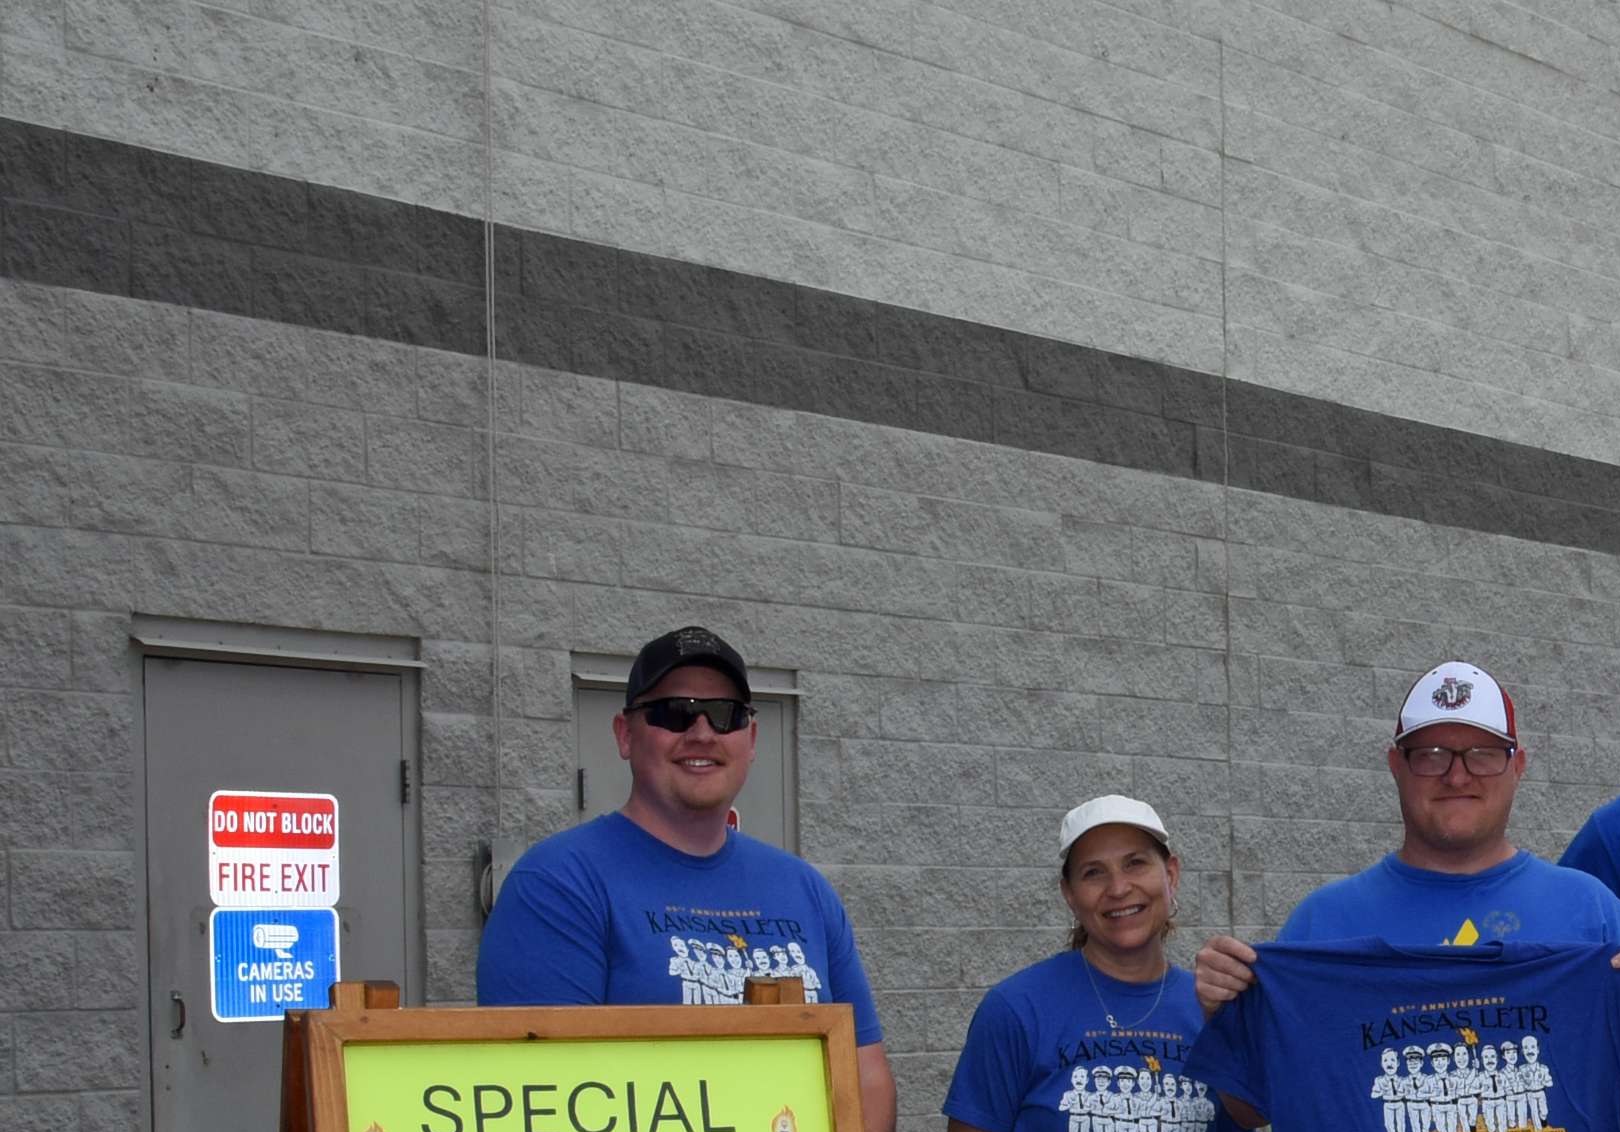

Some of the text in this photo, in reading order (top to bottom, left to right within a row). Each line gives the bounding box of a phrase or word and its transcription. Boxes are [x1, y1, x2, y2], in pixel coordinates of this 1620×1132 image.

[213, 810, 333, 834] DO NOT BLOCK
[218, 862, 330, 892] FIRE EXIT
[644, 910, 807, 944] KANSAS LETR
[237, 960, 315, 982] CAMERAS
[250, 983, 304, 1004] IN USE
[1421, 996, 1506, 1012] ANNIVERSARY
[1360, 1004, 1550, 1051] KANSAS LETR
[1057, 1039, 1157, 1069] KANSAS
